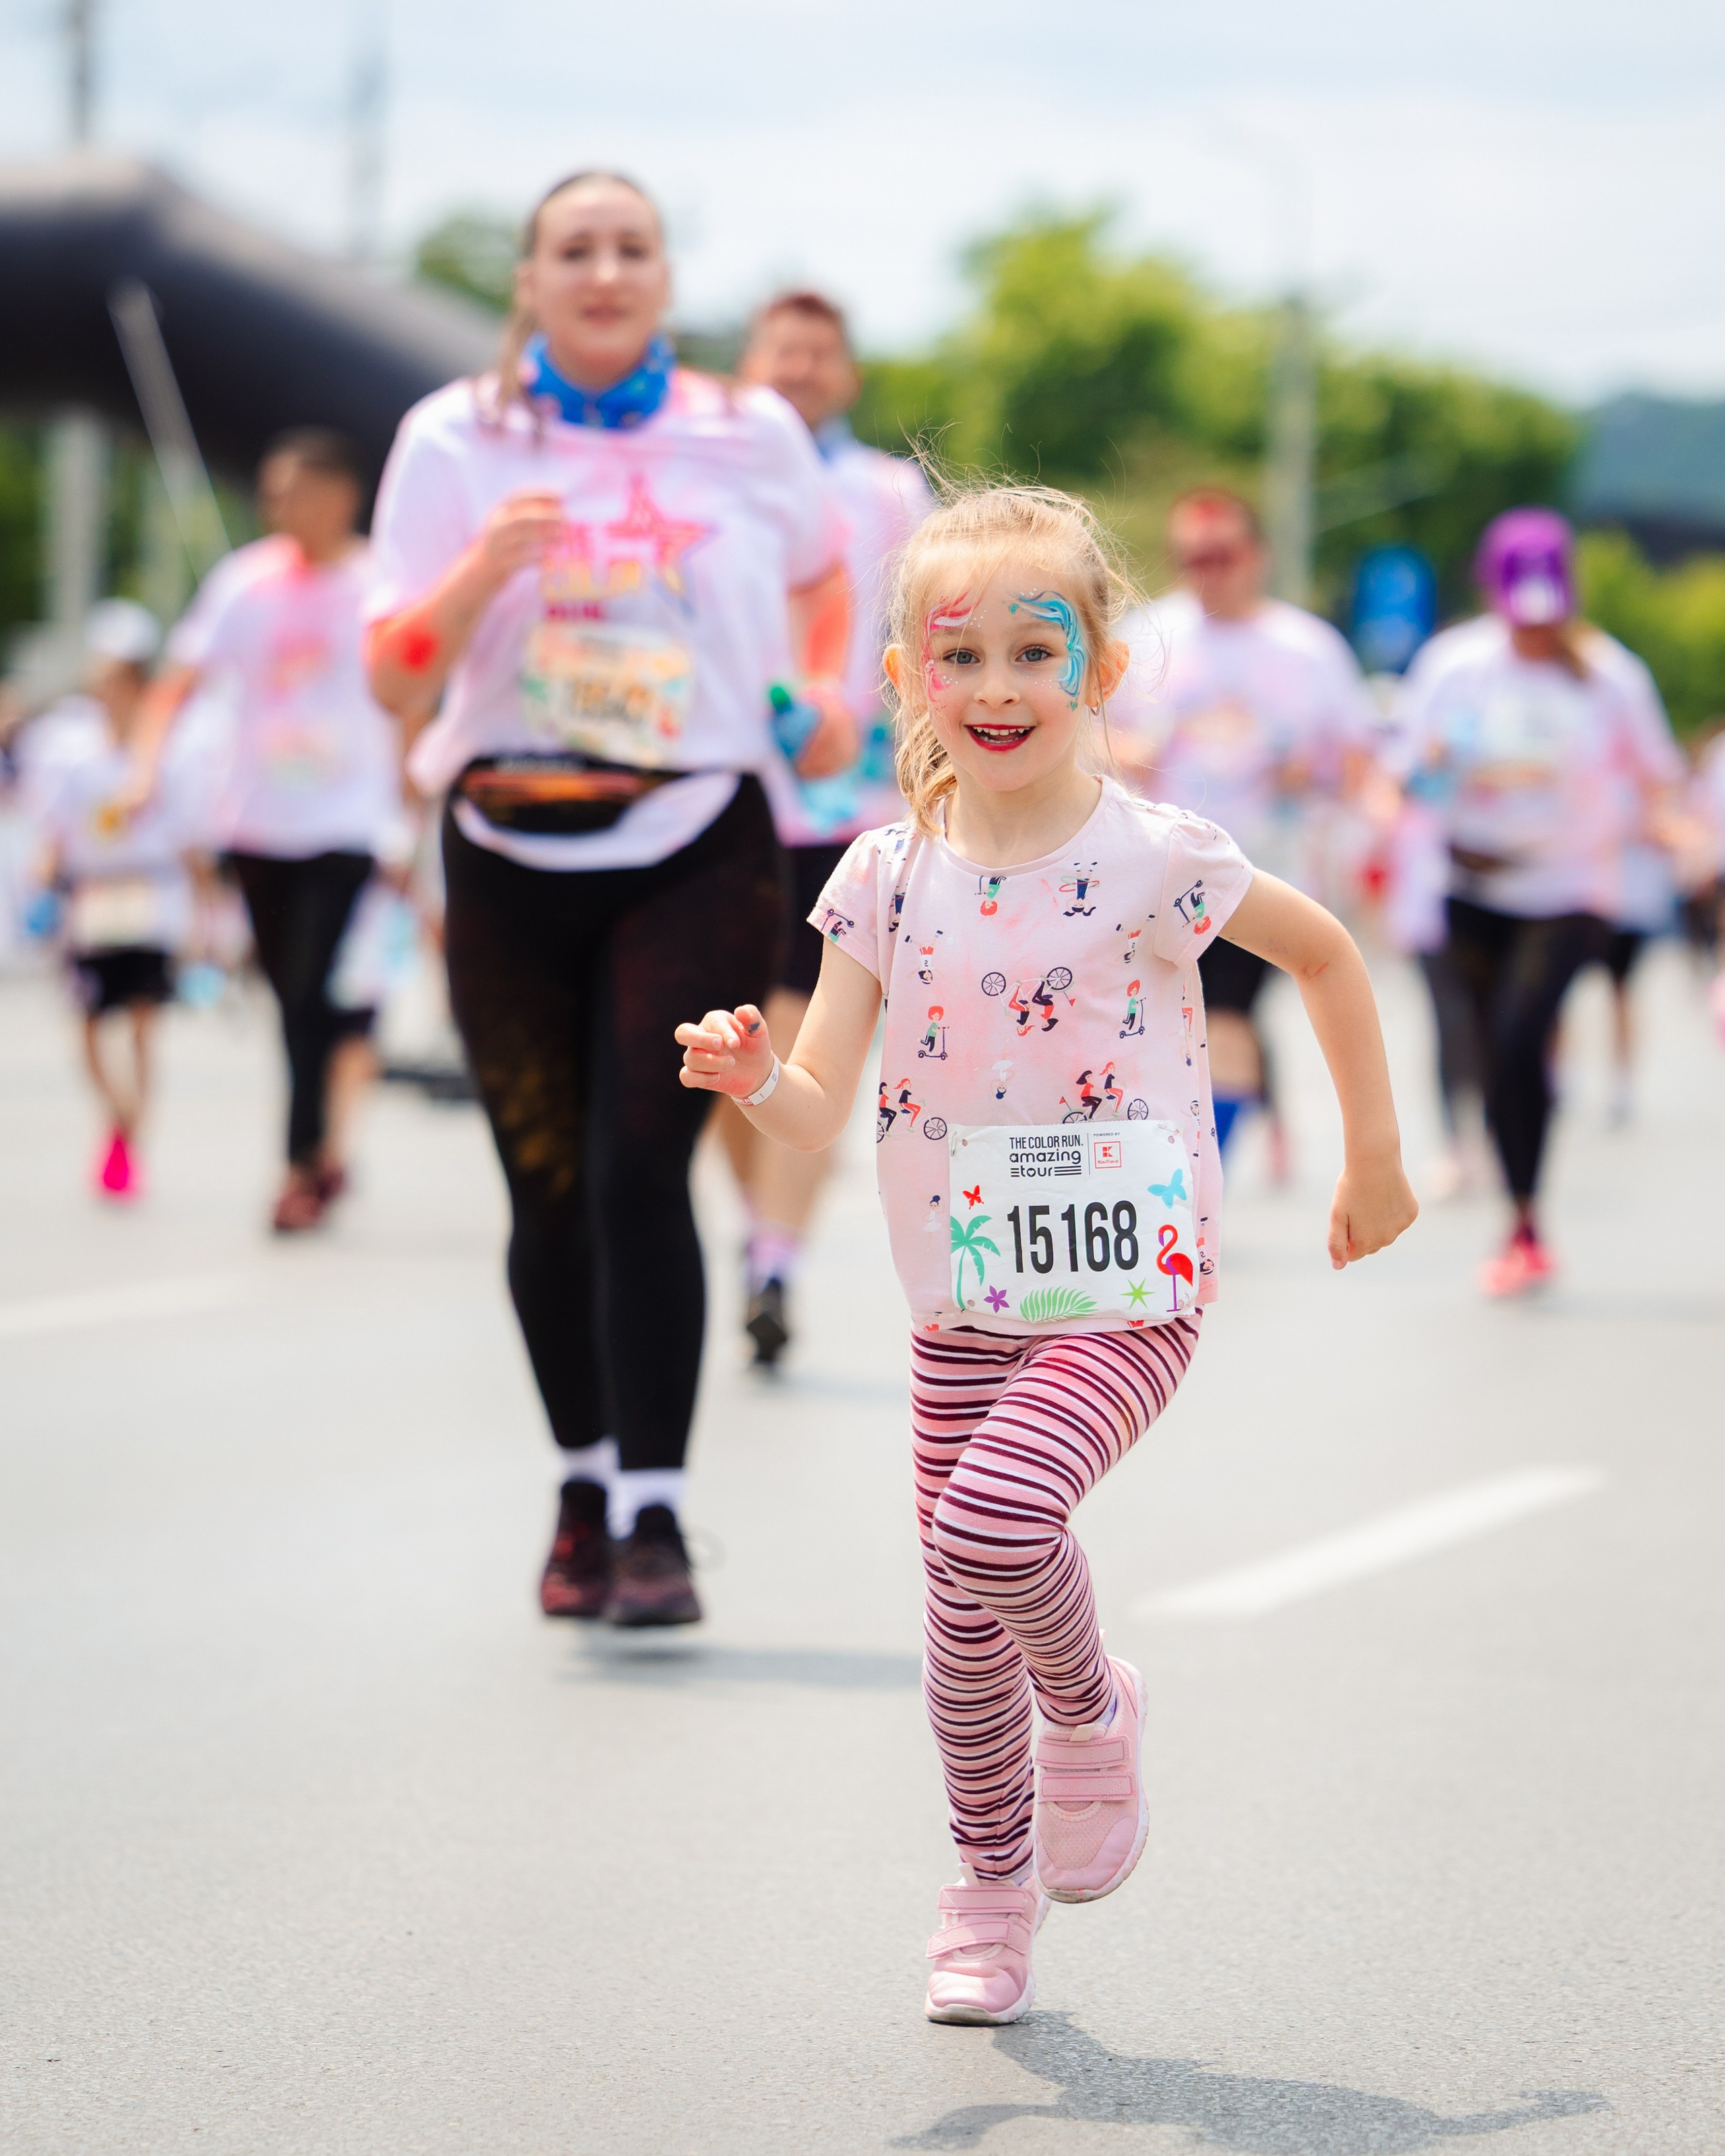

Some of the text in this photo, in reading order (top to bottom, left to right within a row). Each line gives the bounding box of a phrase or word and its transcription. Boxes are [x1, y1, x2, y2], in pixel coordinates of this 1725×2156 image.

[1009, 1137, 1026, 1149] THE
[1028, 1135, 1059, 1148] COLOR
[1009, 1149, 1081, 1164] amazing
[1020, 1165, 1053, 1177] tour
[1007, 1200, 1139, 1273] 15168
